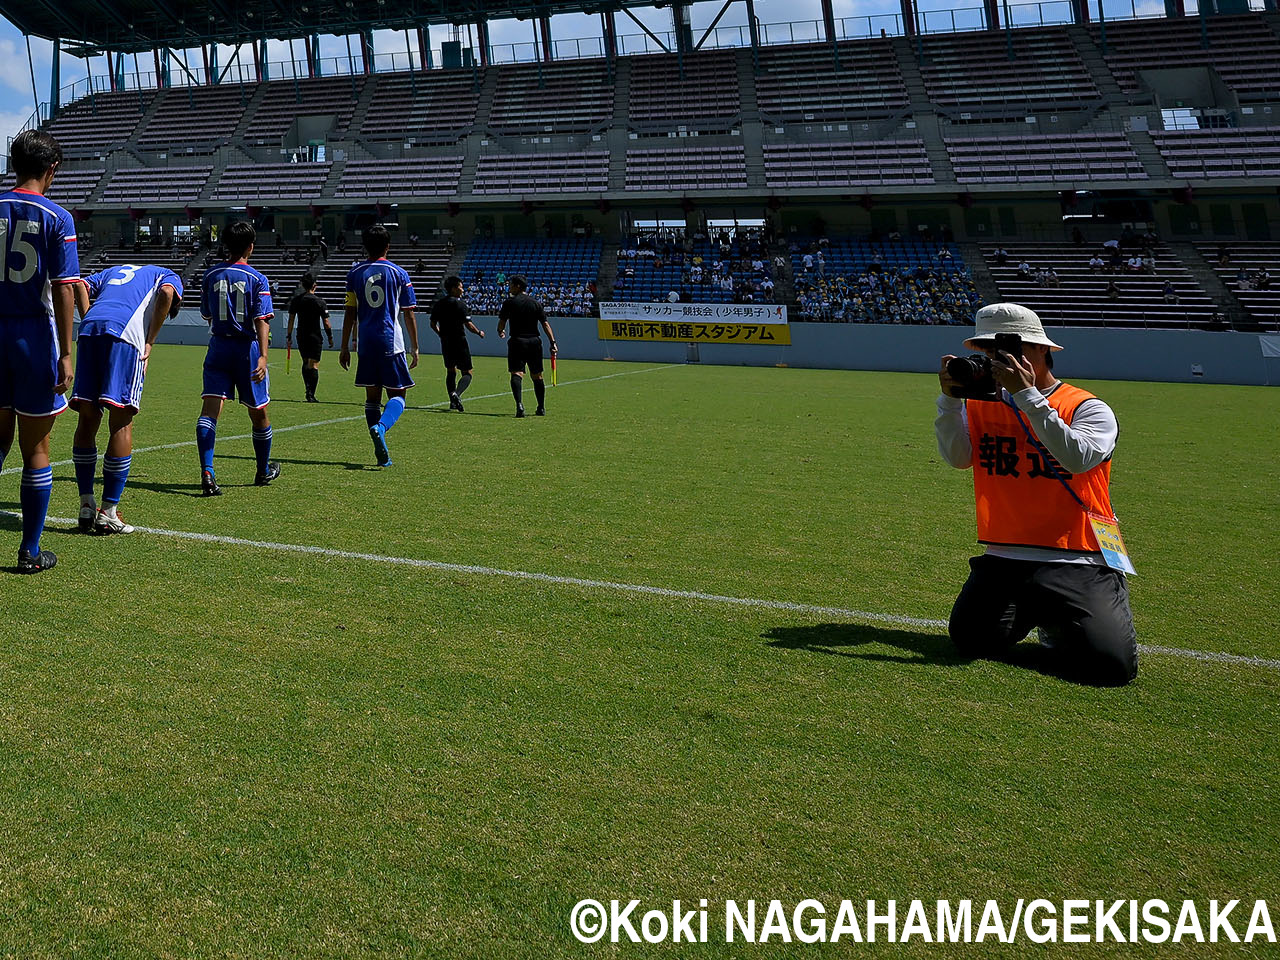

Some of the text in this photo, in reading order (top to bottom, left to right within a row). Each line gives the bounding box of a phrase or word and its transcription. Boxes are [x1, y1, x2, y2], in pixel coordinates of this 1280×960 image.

[107, 263, 143, 286] 3
[213, 279, 247, 323] 11
[364, 272, 385, 309] 6
[611, 322, 775, 341] 駅前不動産スタジアム
